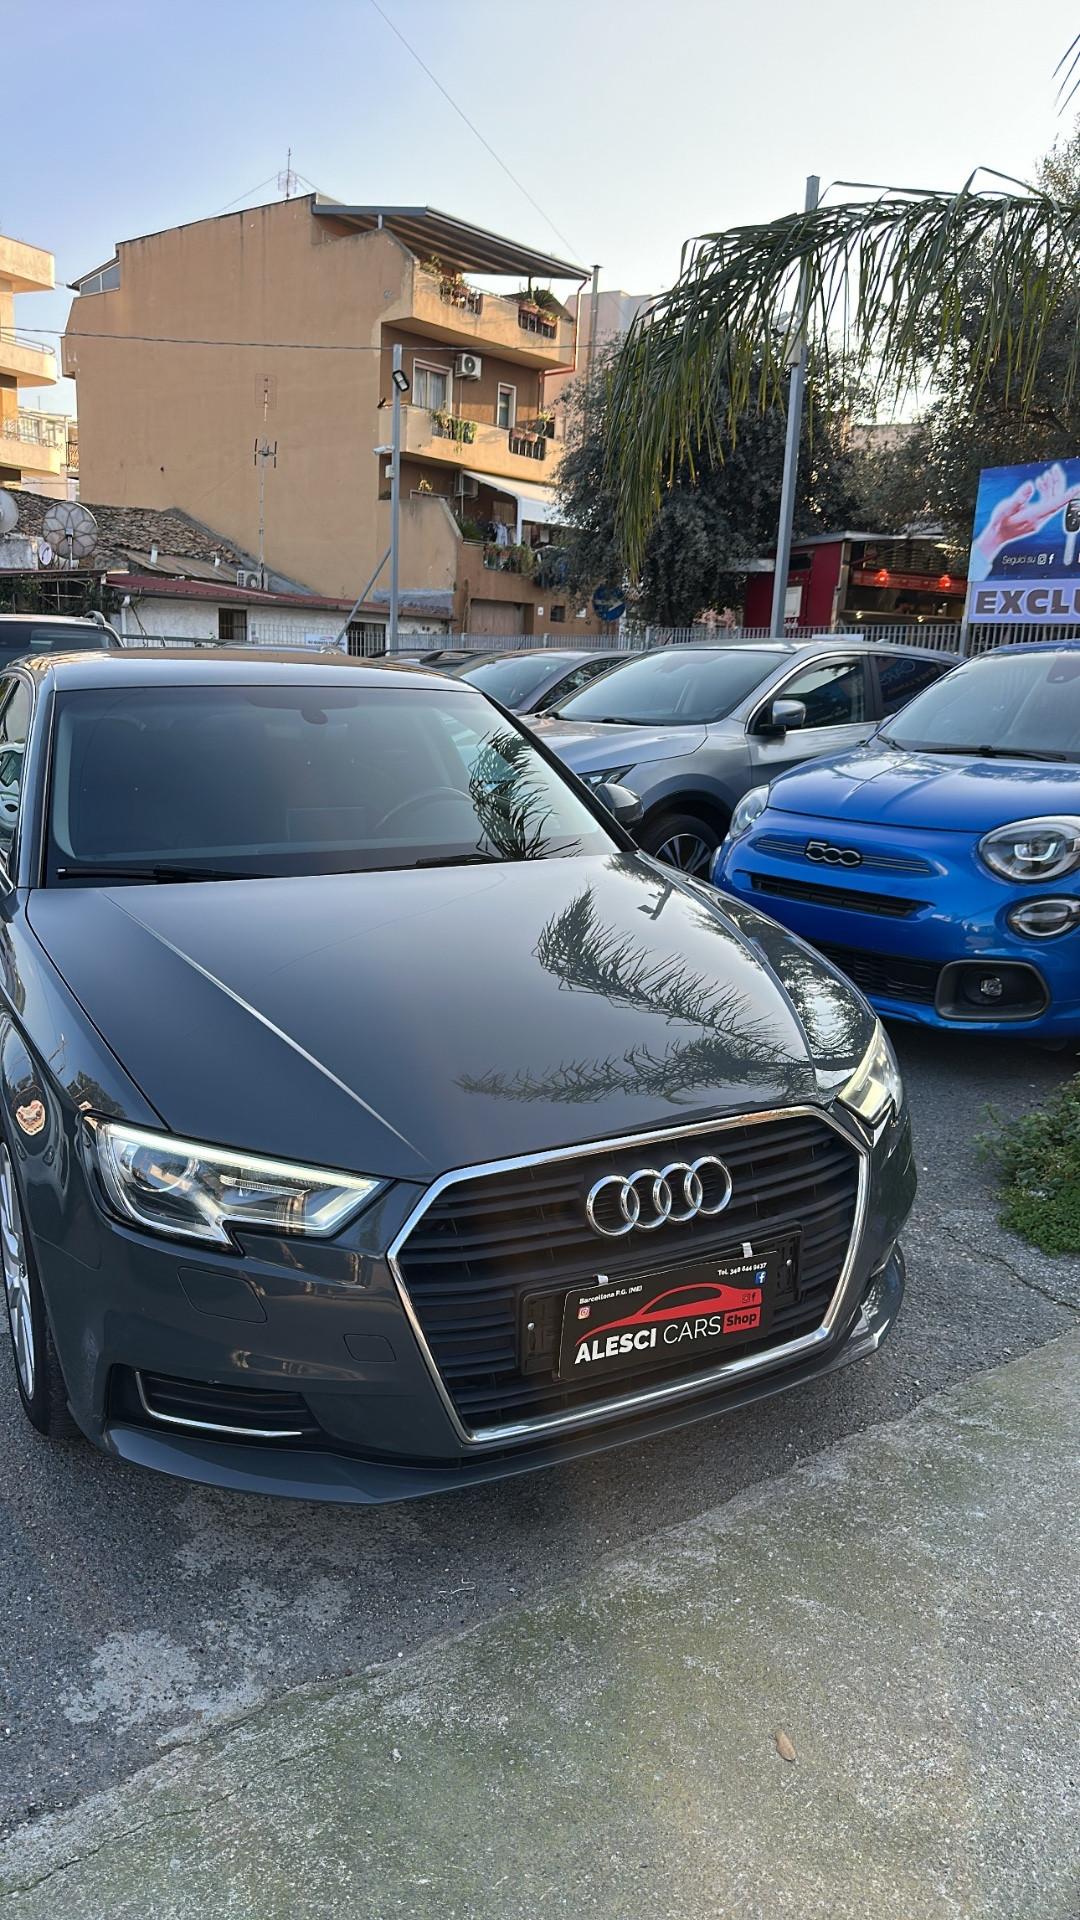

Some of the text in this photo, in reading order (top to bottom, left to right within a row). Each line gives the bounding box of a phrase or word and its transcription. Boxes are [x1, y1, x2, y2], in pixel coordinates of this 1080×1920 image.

[806, 841, 861, 867] 500
[578, 1291, 616, 1305] Barcellona
[574, 1312, 758, 1365] ALESCI CARS Shop
